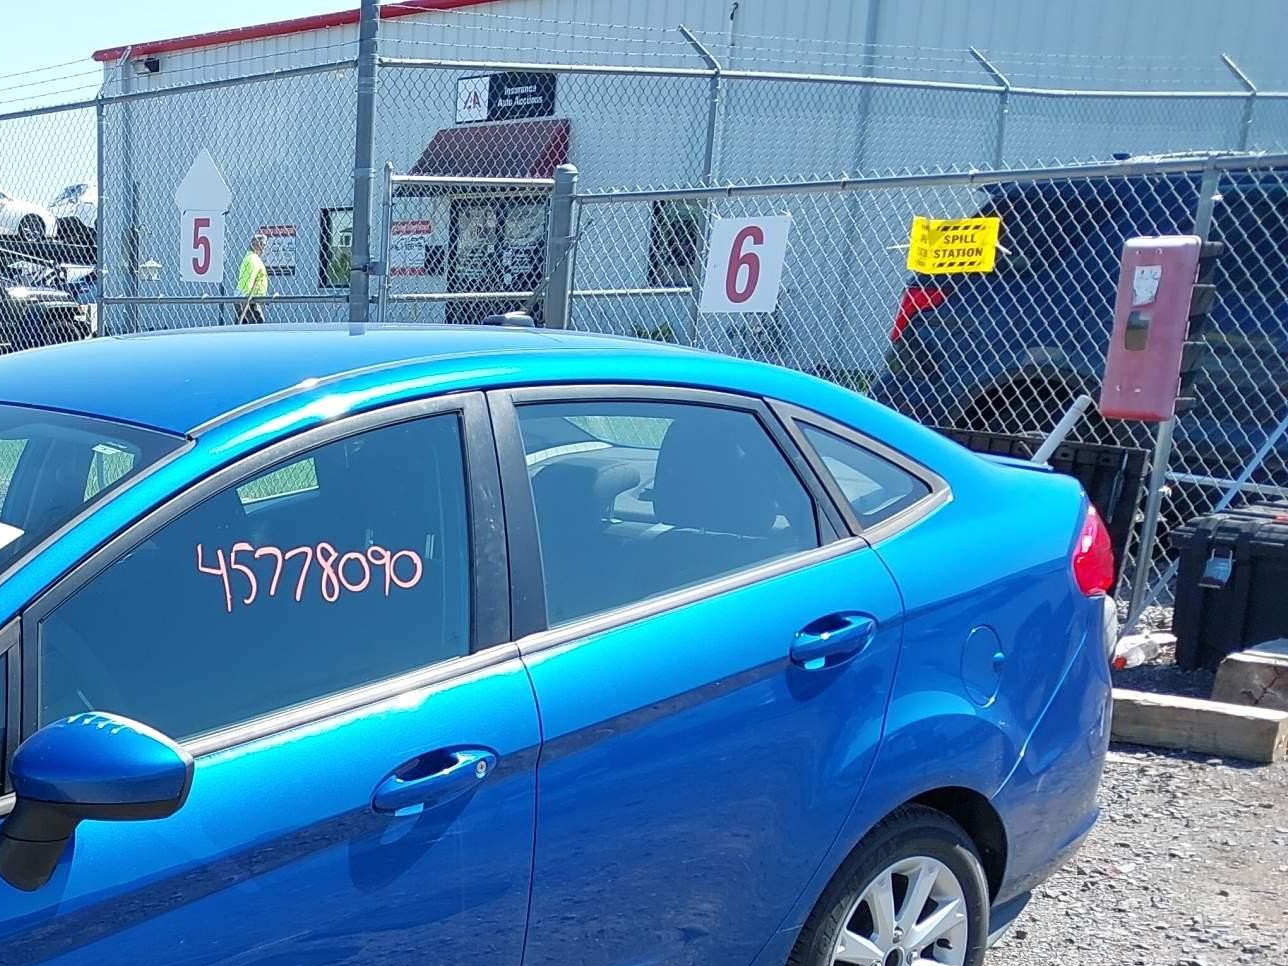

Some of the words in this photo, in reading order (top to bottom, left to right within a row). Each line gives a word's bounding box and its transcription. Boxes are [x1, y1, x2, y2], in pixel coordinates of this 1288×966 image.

[497, 96, 513, 107] Auto
[192, 218, 210, 275] 5
[933, 247, 983, 259] STATION
[943, 234, 976, 245] SPILL
[726, 225, 764, 303] 6
[197, 541, 423, 613] 45778090
